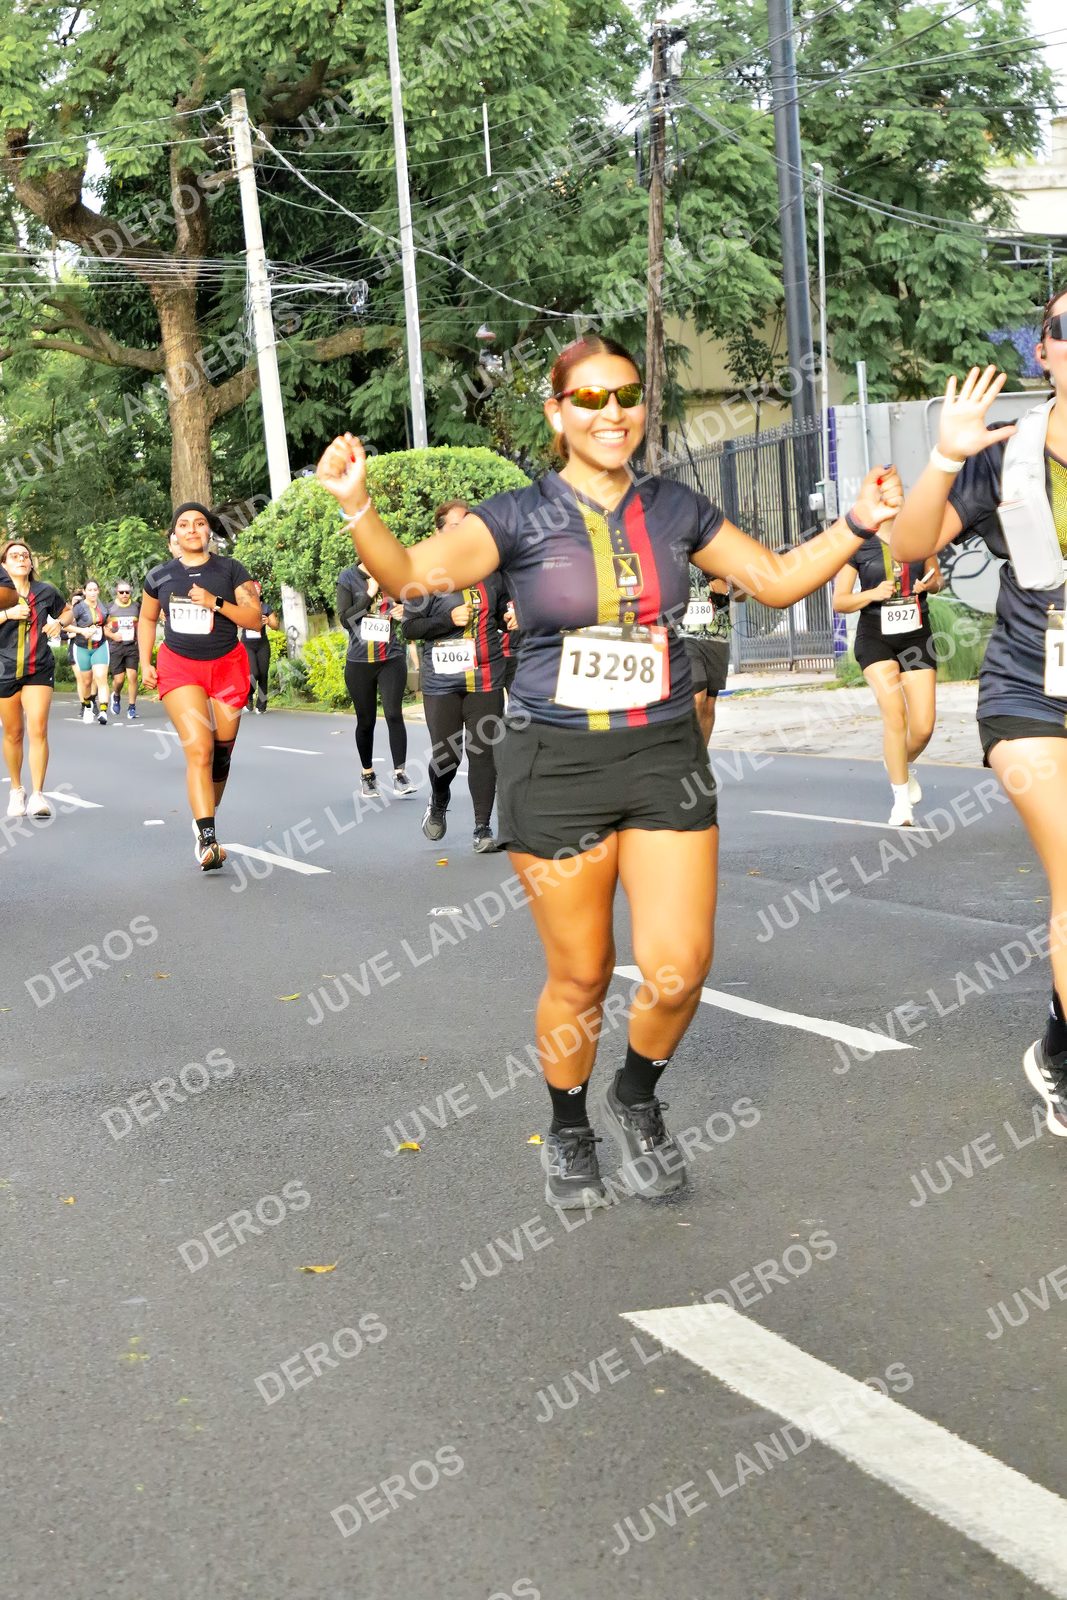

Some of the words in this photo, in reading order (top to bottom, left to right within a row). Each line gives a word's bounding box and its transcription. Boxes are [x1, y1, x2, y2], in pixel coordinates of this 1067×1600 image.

[887, 609, 916, 622] 8927
[363, 621, 390, 633] 12628
[435, 651, 471, 663] 12062
[569, 650, 655, 683] 13298
